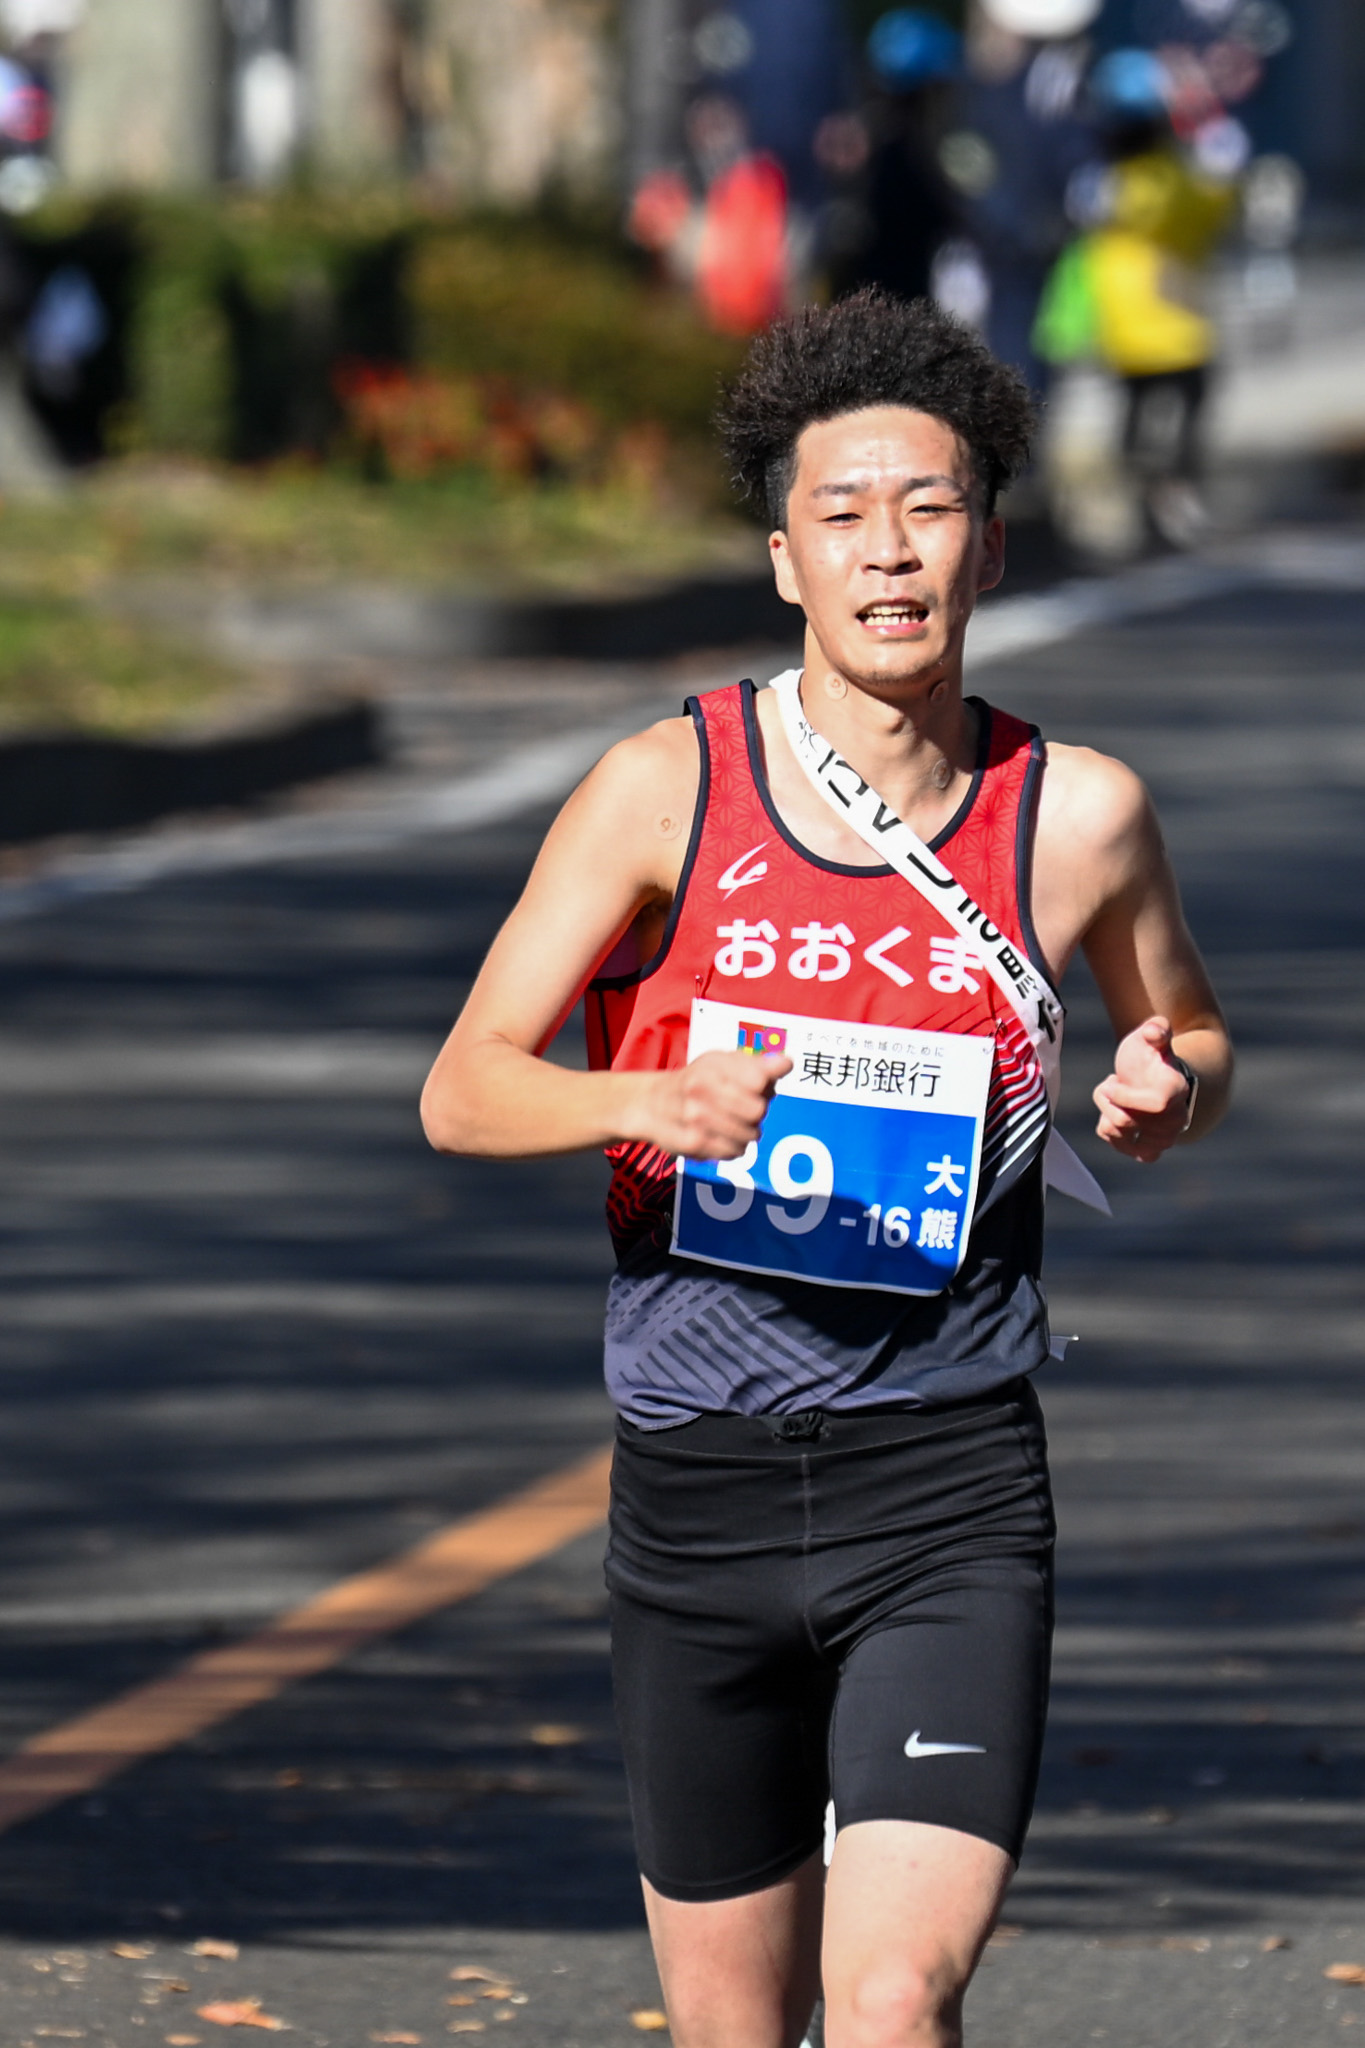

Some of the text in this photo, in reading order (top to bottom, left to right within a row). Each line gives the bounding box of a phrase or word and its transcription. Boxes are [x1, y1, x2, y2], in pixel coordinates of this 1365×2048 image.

[714, 919, 984, 995] おおくま
[799, 1051, 941, 1098] 東邦銀行
[916, 1155, 966, 1250] 大熊
